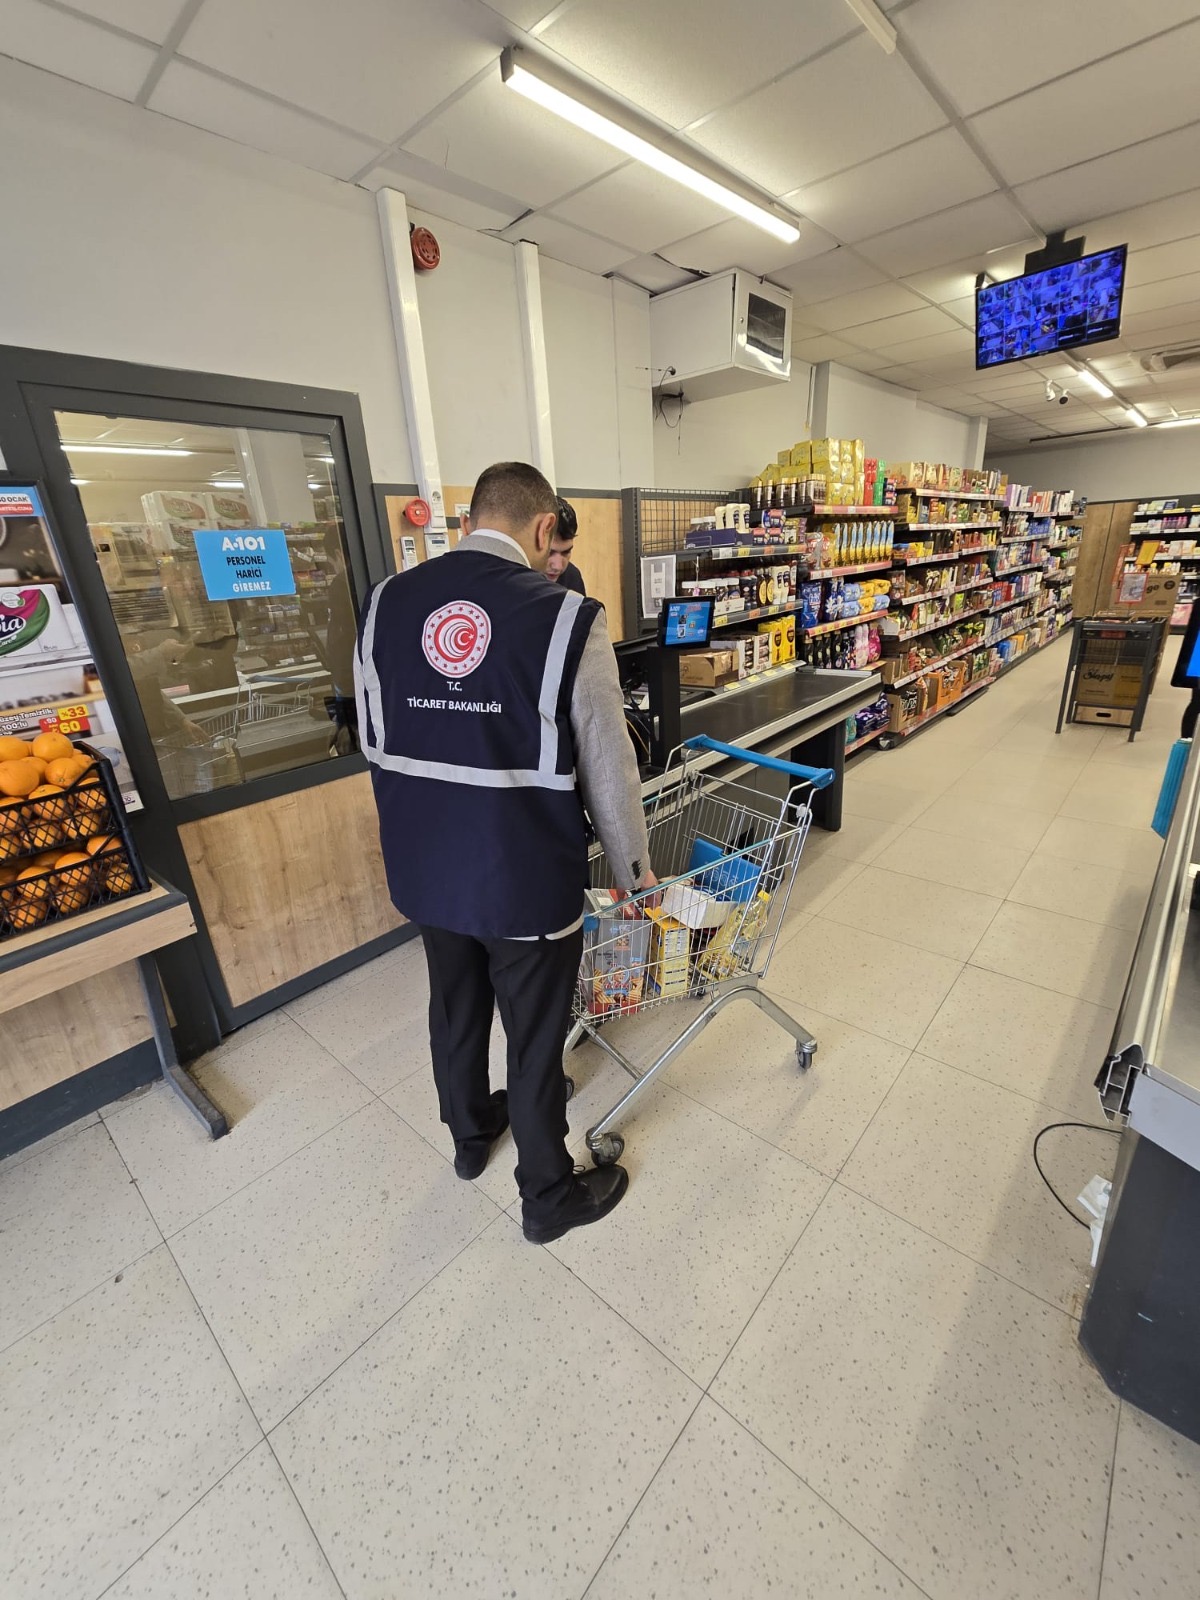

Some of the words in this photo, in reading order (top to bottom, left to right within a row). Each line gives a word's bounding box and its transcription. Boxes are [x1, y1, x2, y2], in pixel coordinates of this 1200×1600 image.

[226, 555, 266, 567] PERSONEL
[236, 567, 263, 579] HARİCİ
[232, 580, 272, 592] GİREMEZ
[0, 614, 24, 633] ia
[446, 681, 463, 691] T.C.
[407, 696, 447, 710] TİCARET
[448, 700, 502, 713] BAKANLIĞI
[20, 708, 53, 720] Temizlik
[61, 706, 86, 719] %33
